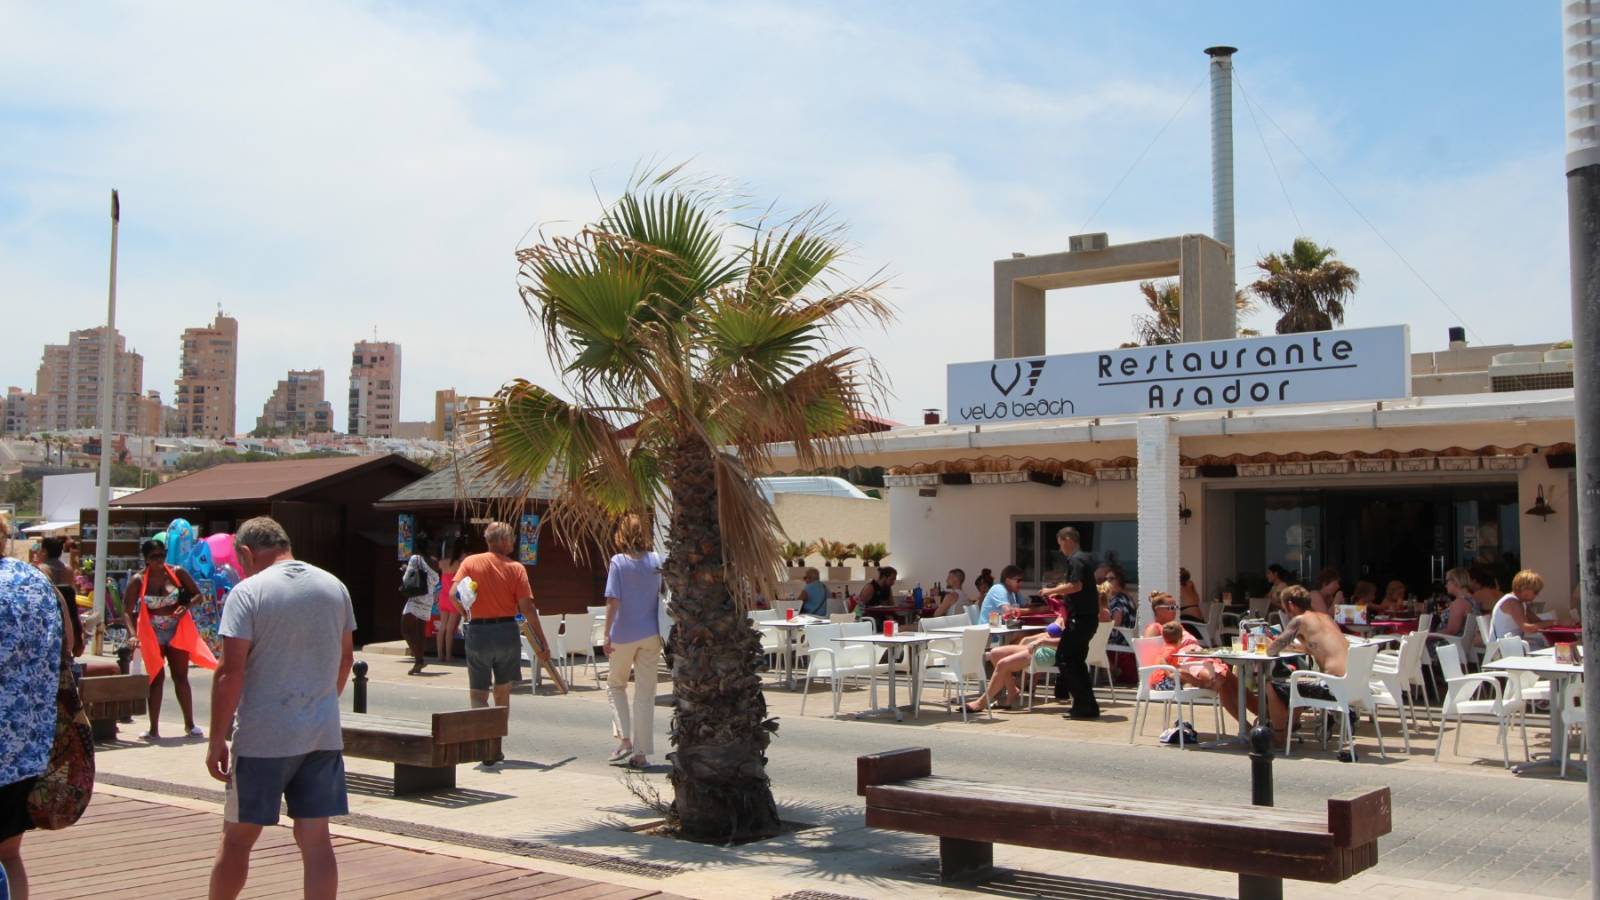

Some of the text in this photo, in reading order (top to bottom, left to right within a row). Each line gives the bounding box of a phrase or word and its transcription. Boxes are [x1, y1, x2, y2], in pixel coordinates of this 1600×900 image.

[1098, 337, 1353, 378] Restaurante
[1012, 397, 1075, 418] beach
[1148, 379, 1290, 409] Asador
